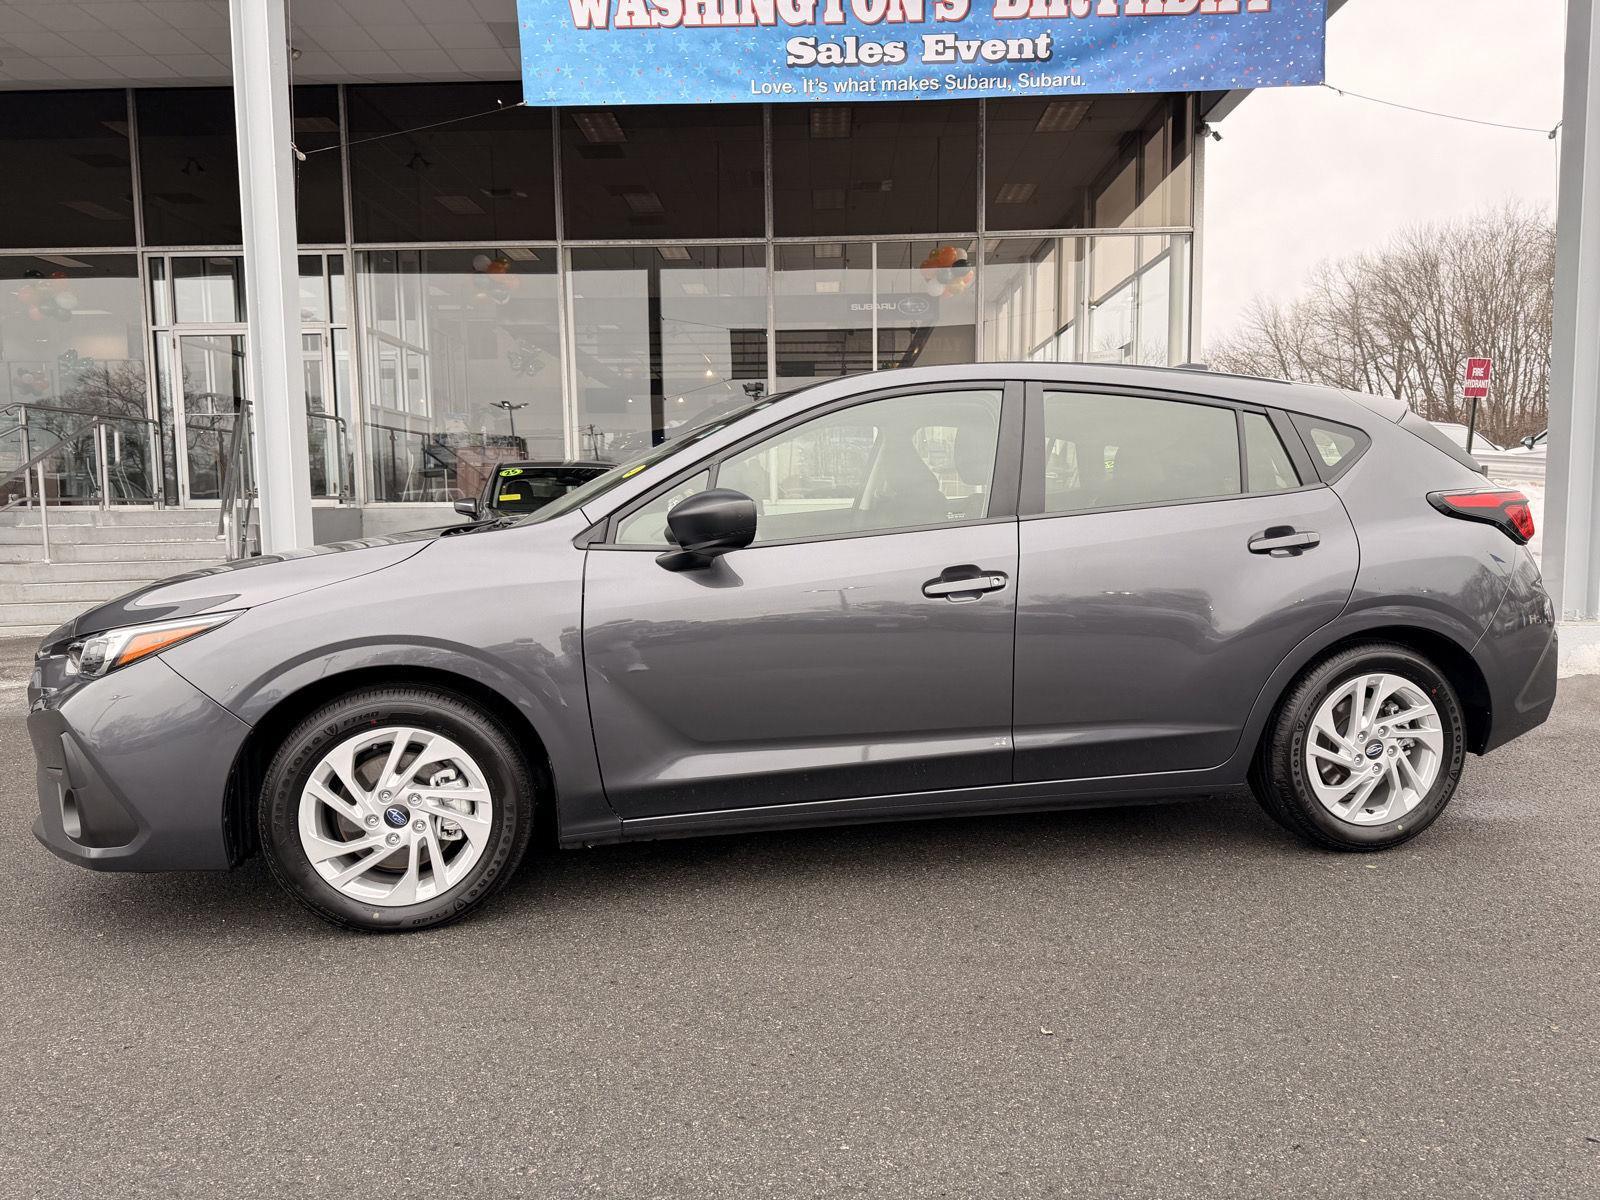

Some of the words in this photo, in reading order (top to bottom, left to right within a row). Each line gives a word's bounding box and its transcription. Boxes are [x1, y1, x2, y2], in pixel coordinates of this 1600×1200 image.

[568, 0, 972, 29] WASHINGTONS
[786, 36, 908, 67] Sales
[921, 33, 1053, 63] Event
[751, 79, 797, 94] Love.
[833, 77, 877, 93] what
[881, 75, 940, 91] makes
[944, 73, 1012, 91] Subaru,
[1018, 72, 1087, 88] Subaru.
[850, 303, 897, 311] SUBARU
